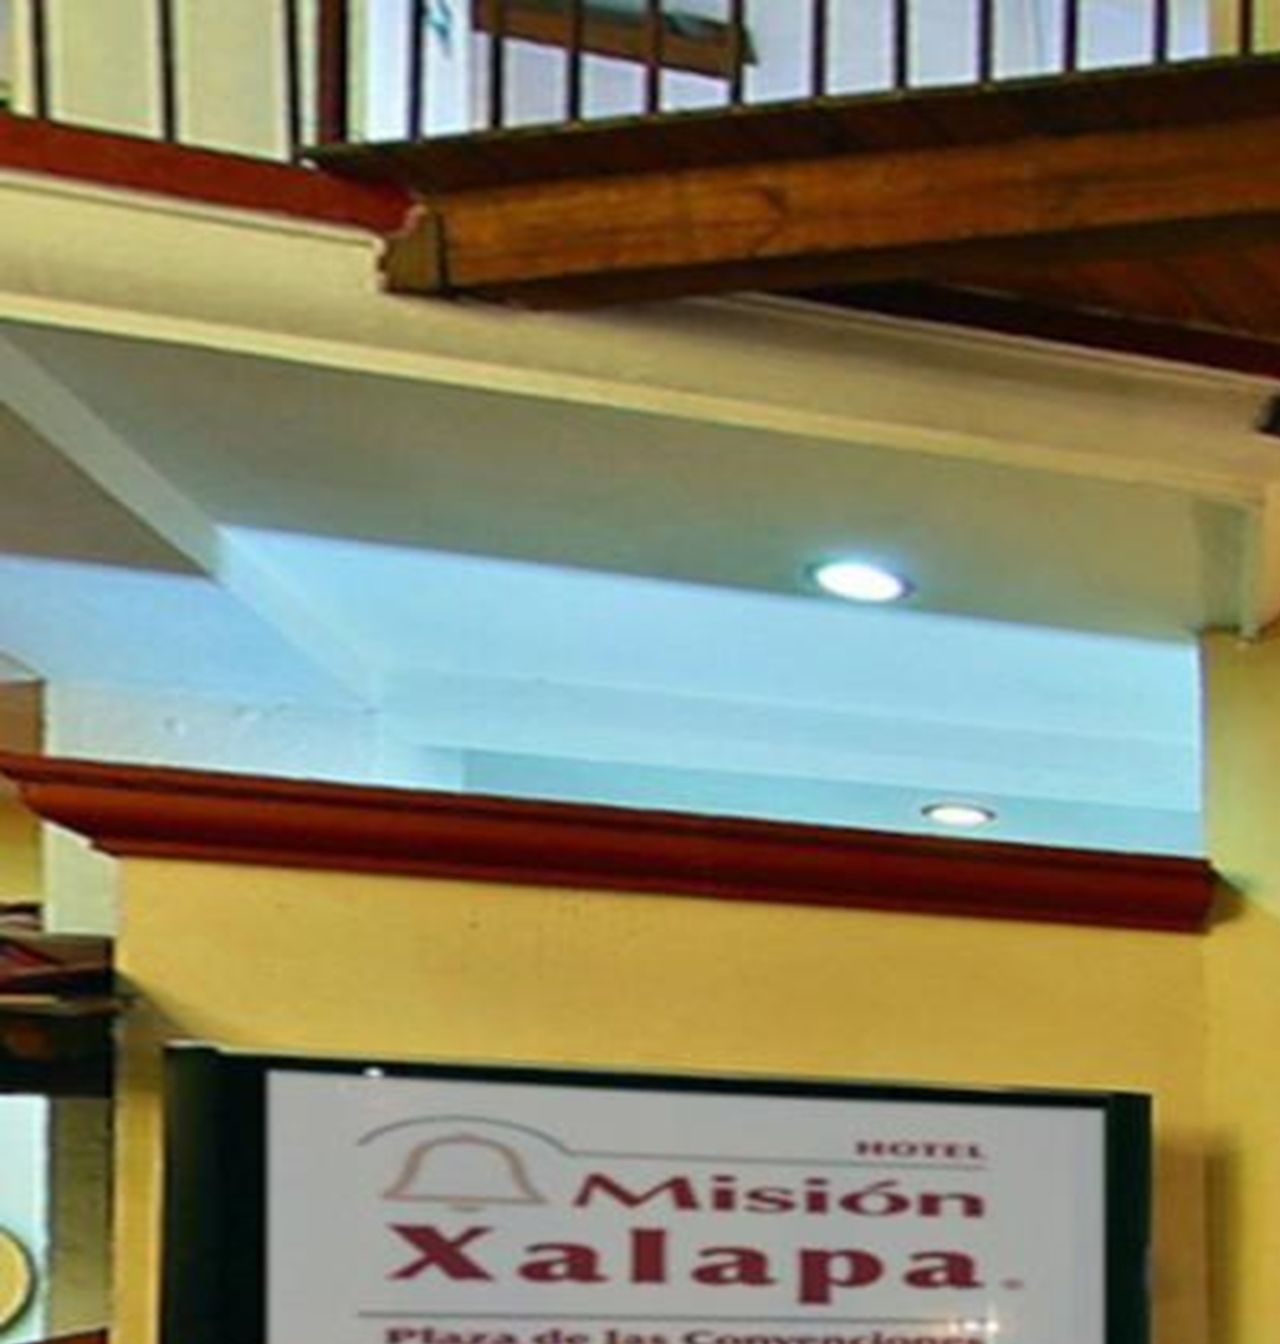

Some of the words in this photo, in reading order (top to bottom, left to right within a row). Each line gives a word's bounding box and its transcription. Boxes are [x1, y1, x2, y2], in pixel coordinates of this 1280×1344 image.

[855, 1140, 988, 1159] HOTEL
[572, 1173, 987, 1219] Misión
[388, 1224, 985, 1306] Xalapa
